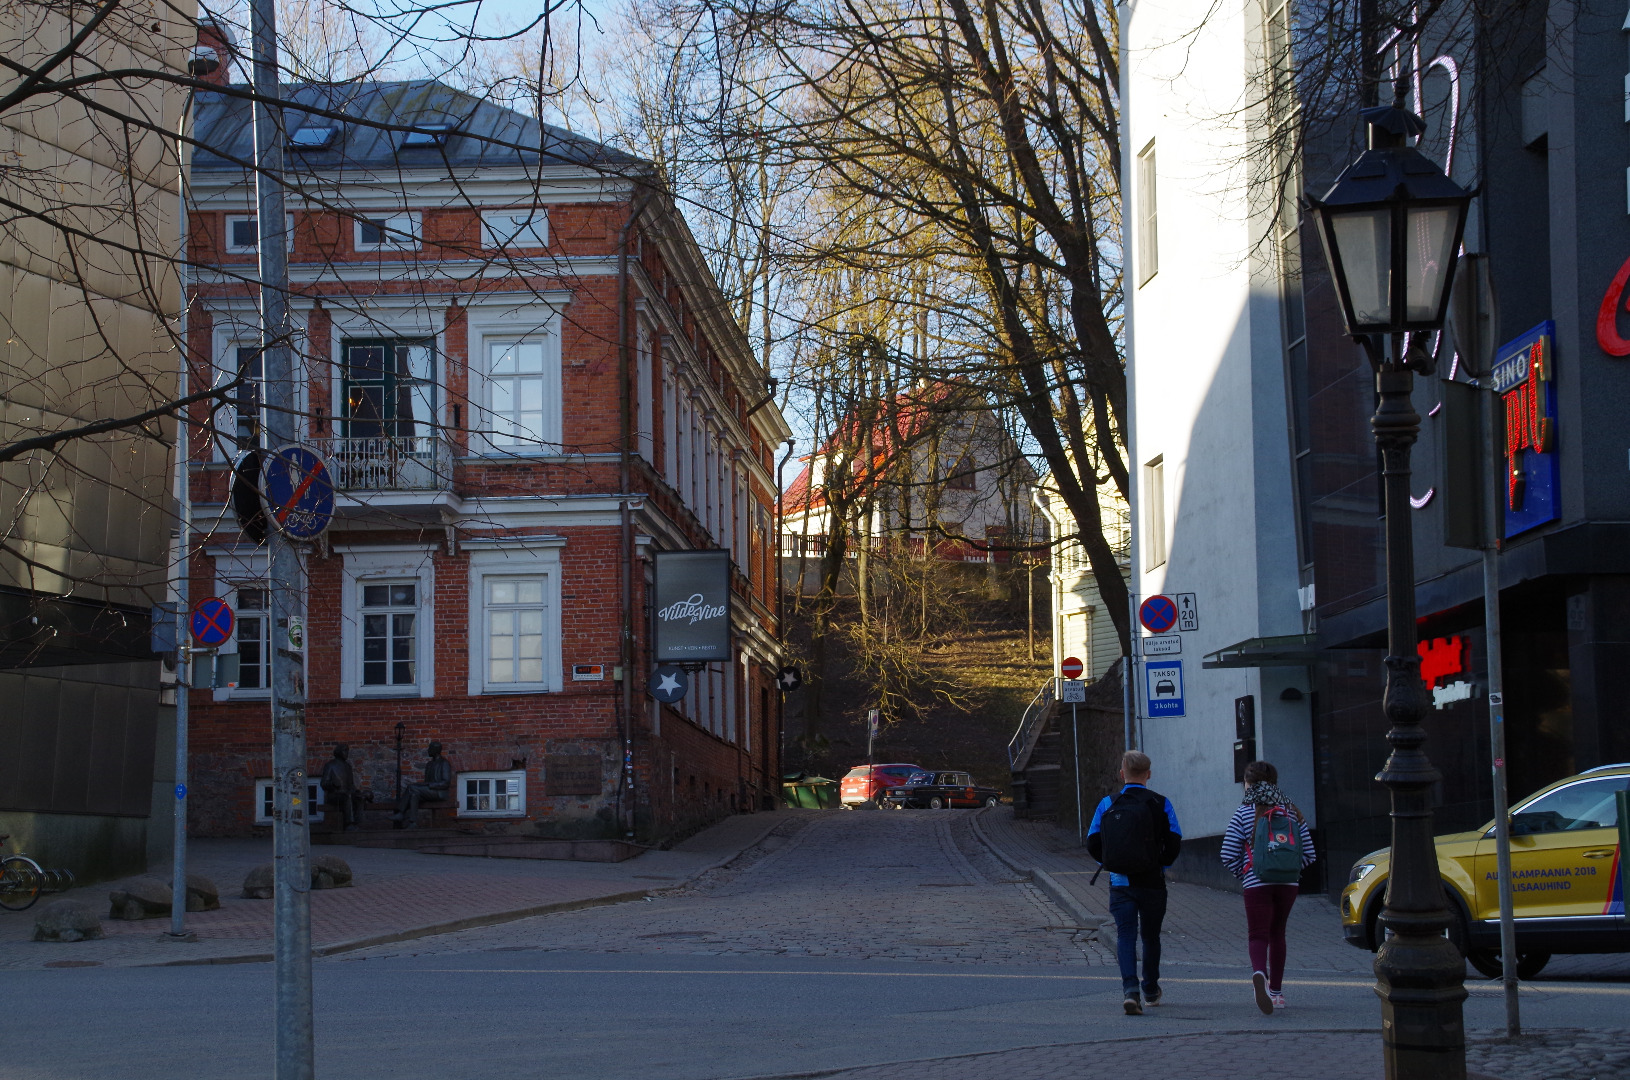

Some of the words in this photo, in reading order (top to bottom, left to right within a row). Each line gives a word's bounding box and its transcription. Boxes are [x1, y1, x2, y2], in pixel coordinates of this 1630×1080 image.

[658, 594, 702, 621] Vilde
[693, 605, 726, 621] Vine
[1181, 610, 1194, 620] 20
[1184, 620, 1194, 628] m
[1485, 868, 1572, 880] AUKAMPAANIA
[1574, 867, 1597, 876] 2018
[1512, 881, 1571, 892] LISAAUHIND
